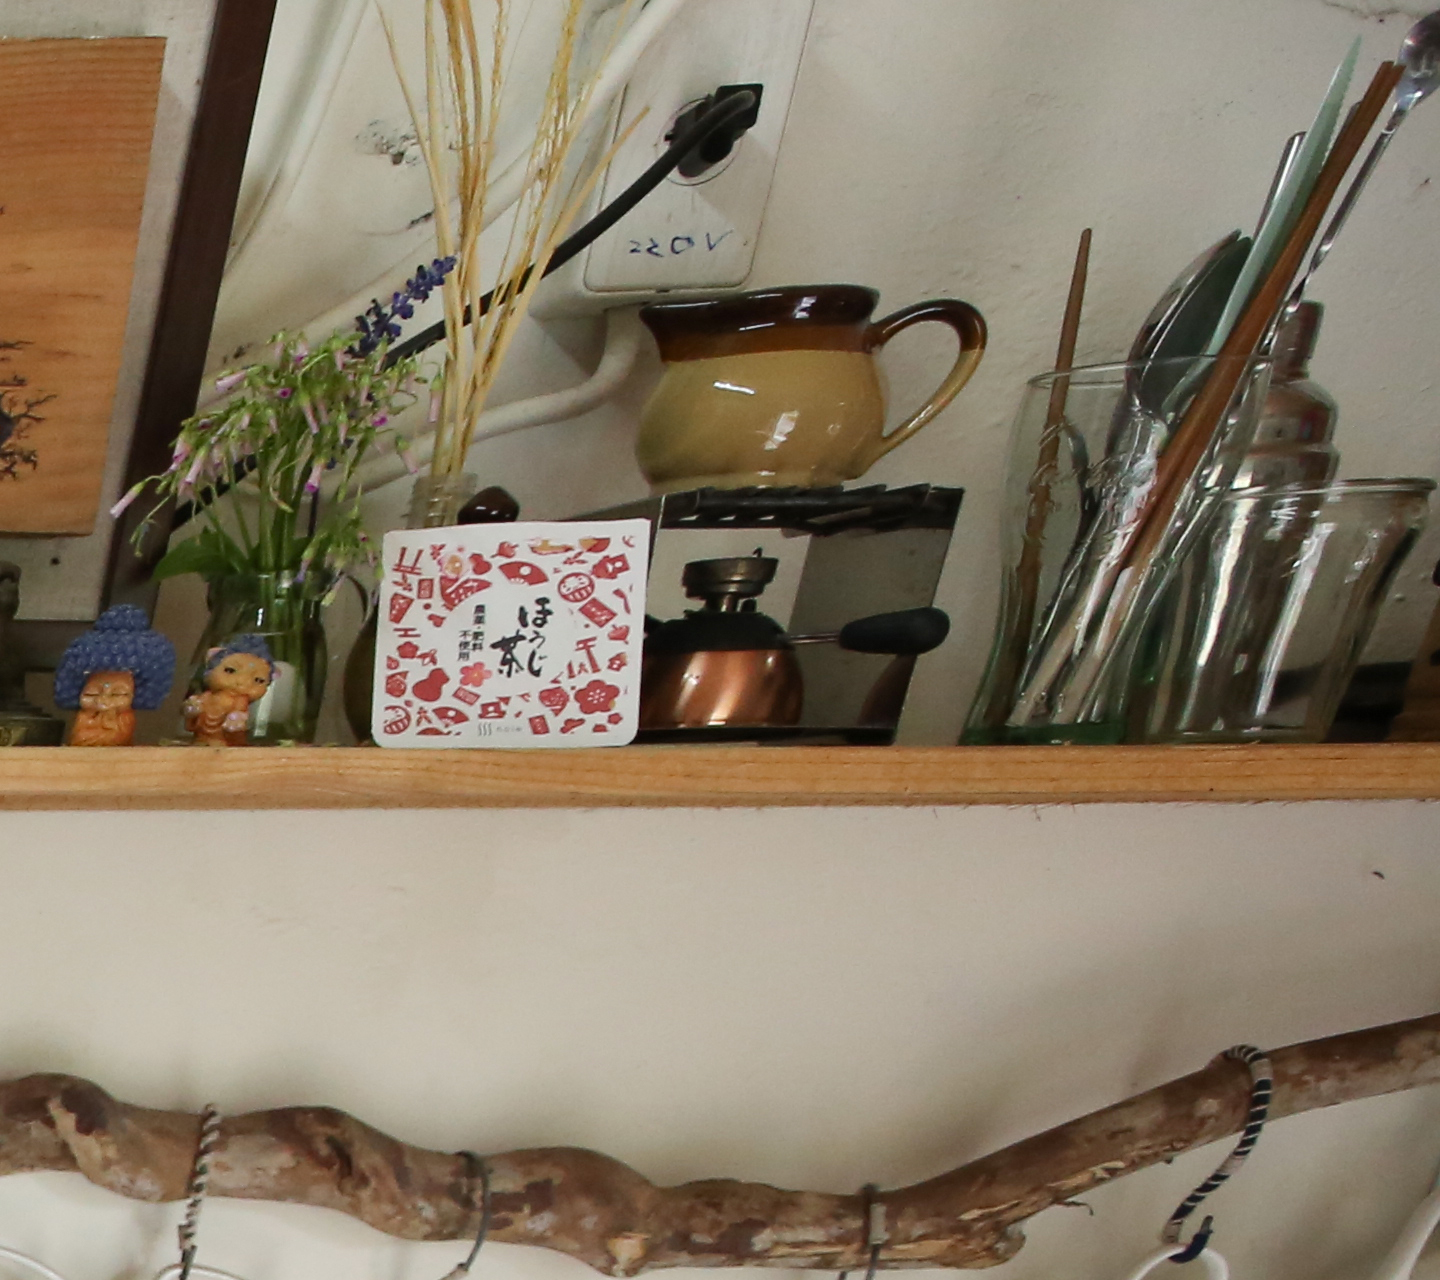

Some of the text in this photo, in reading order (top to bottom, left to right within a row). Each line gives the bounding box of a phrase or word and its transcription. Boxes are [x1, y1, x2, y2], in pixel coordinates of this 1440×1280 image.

[490, 628, 527, 678] 茶
[517, 597, 554, 678] ほうじ
